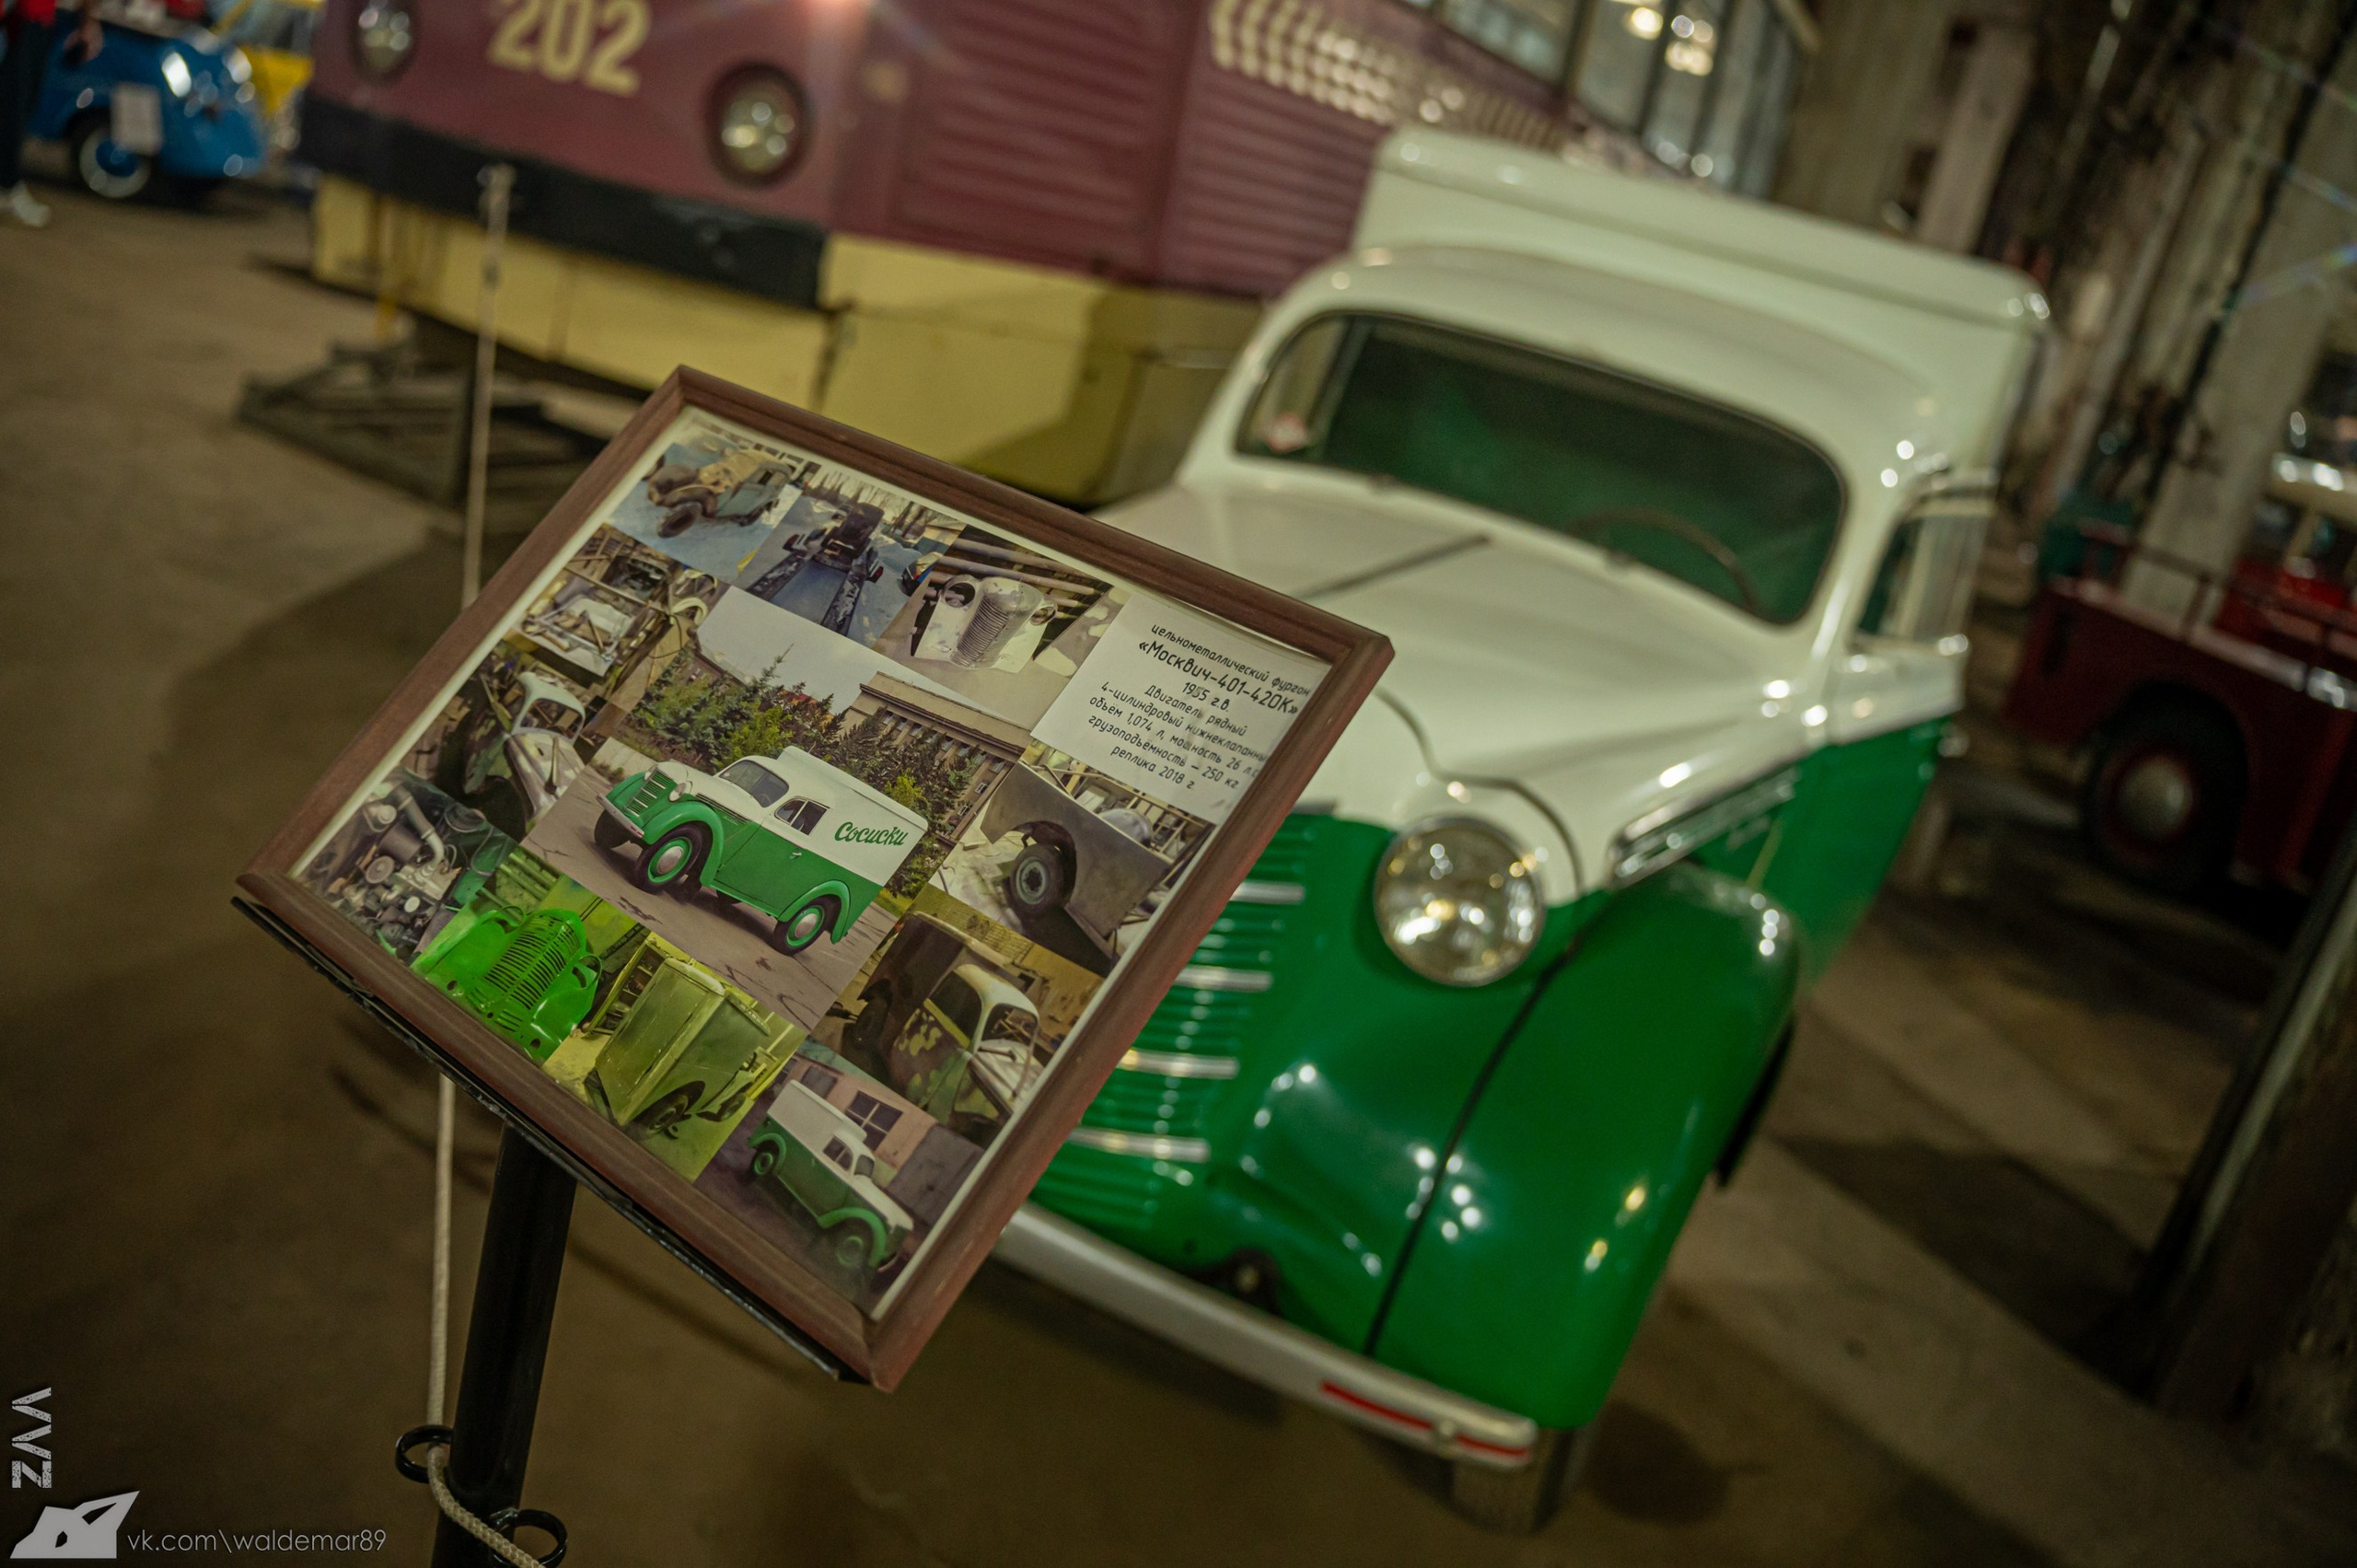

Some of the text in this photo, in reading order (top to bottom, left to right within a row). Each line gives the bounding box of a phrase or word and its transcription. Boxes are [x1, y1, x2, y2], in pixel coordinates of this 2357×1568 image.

[488, 0, 651, 96] 202
[1151, 624, 1310, 697] цельнометаллический фургон
[1101, 681, 1267, 762] 4-цилиндровый нижнеклапанны
[1144, 684, 1248, 737] Двигатель рядный
[1211, 697, 1230, 713] г.в.
[1110, 746, 1156, 772] реплика
[1158, 765, 1186, 784] 2018
[1127, 713, 1154, 731] 1,074
[1169, 735, 1222, 763] мощность
[1225, 757, 1243, 771] 26
[1202, 766, 1225, 782] 250
[834, 821, 909, 846] Сосиски
